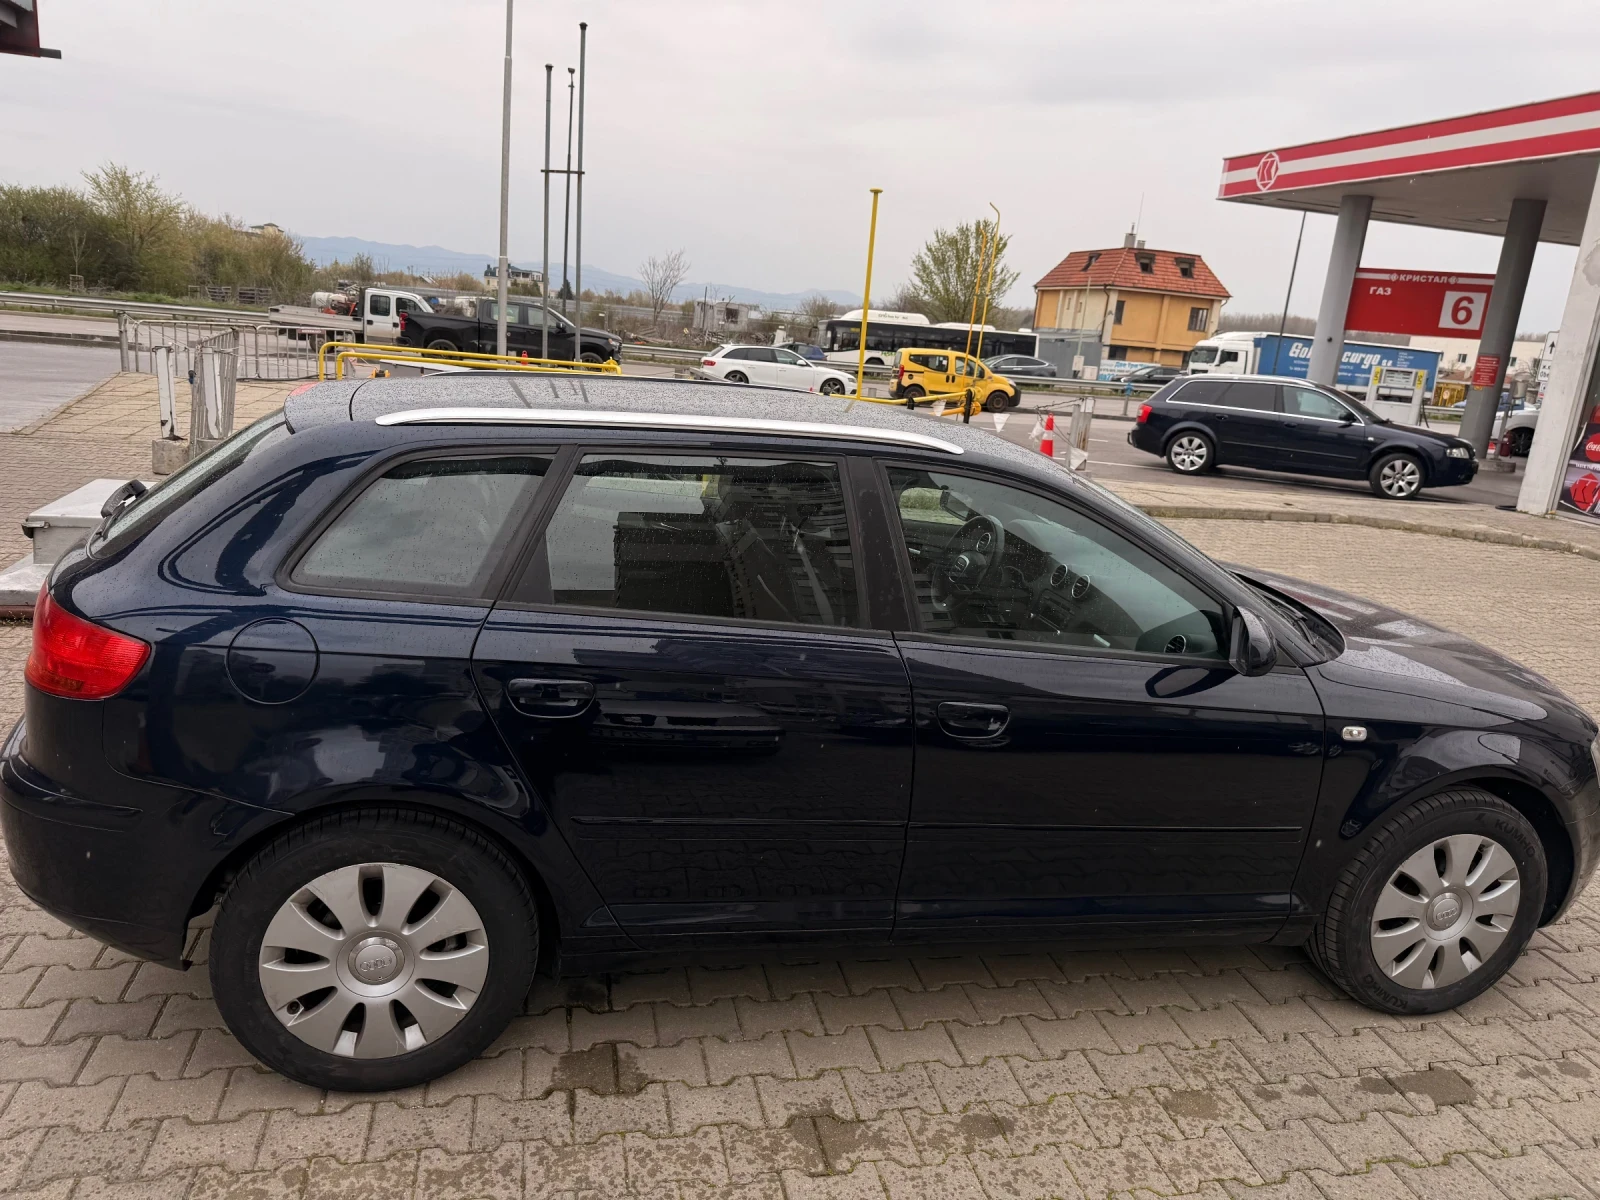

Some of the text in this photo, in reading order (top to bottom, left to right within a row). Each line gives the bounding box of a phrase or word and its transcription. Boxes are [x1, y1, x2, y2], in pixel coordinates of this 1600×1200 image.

[1399, 273, 1448, 284] КРИСТАЛ
[1369, 286, 1392, 296] ГАЗ
[1451, 296, 1475, 325] 6
[1341, 351, 1381, 369] cargo
[1494, 819, 1536, 858] KUMHO
[1363, 973, 1409, 1010] KUMHO
